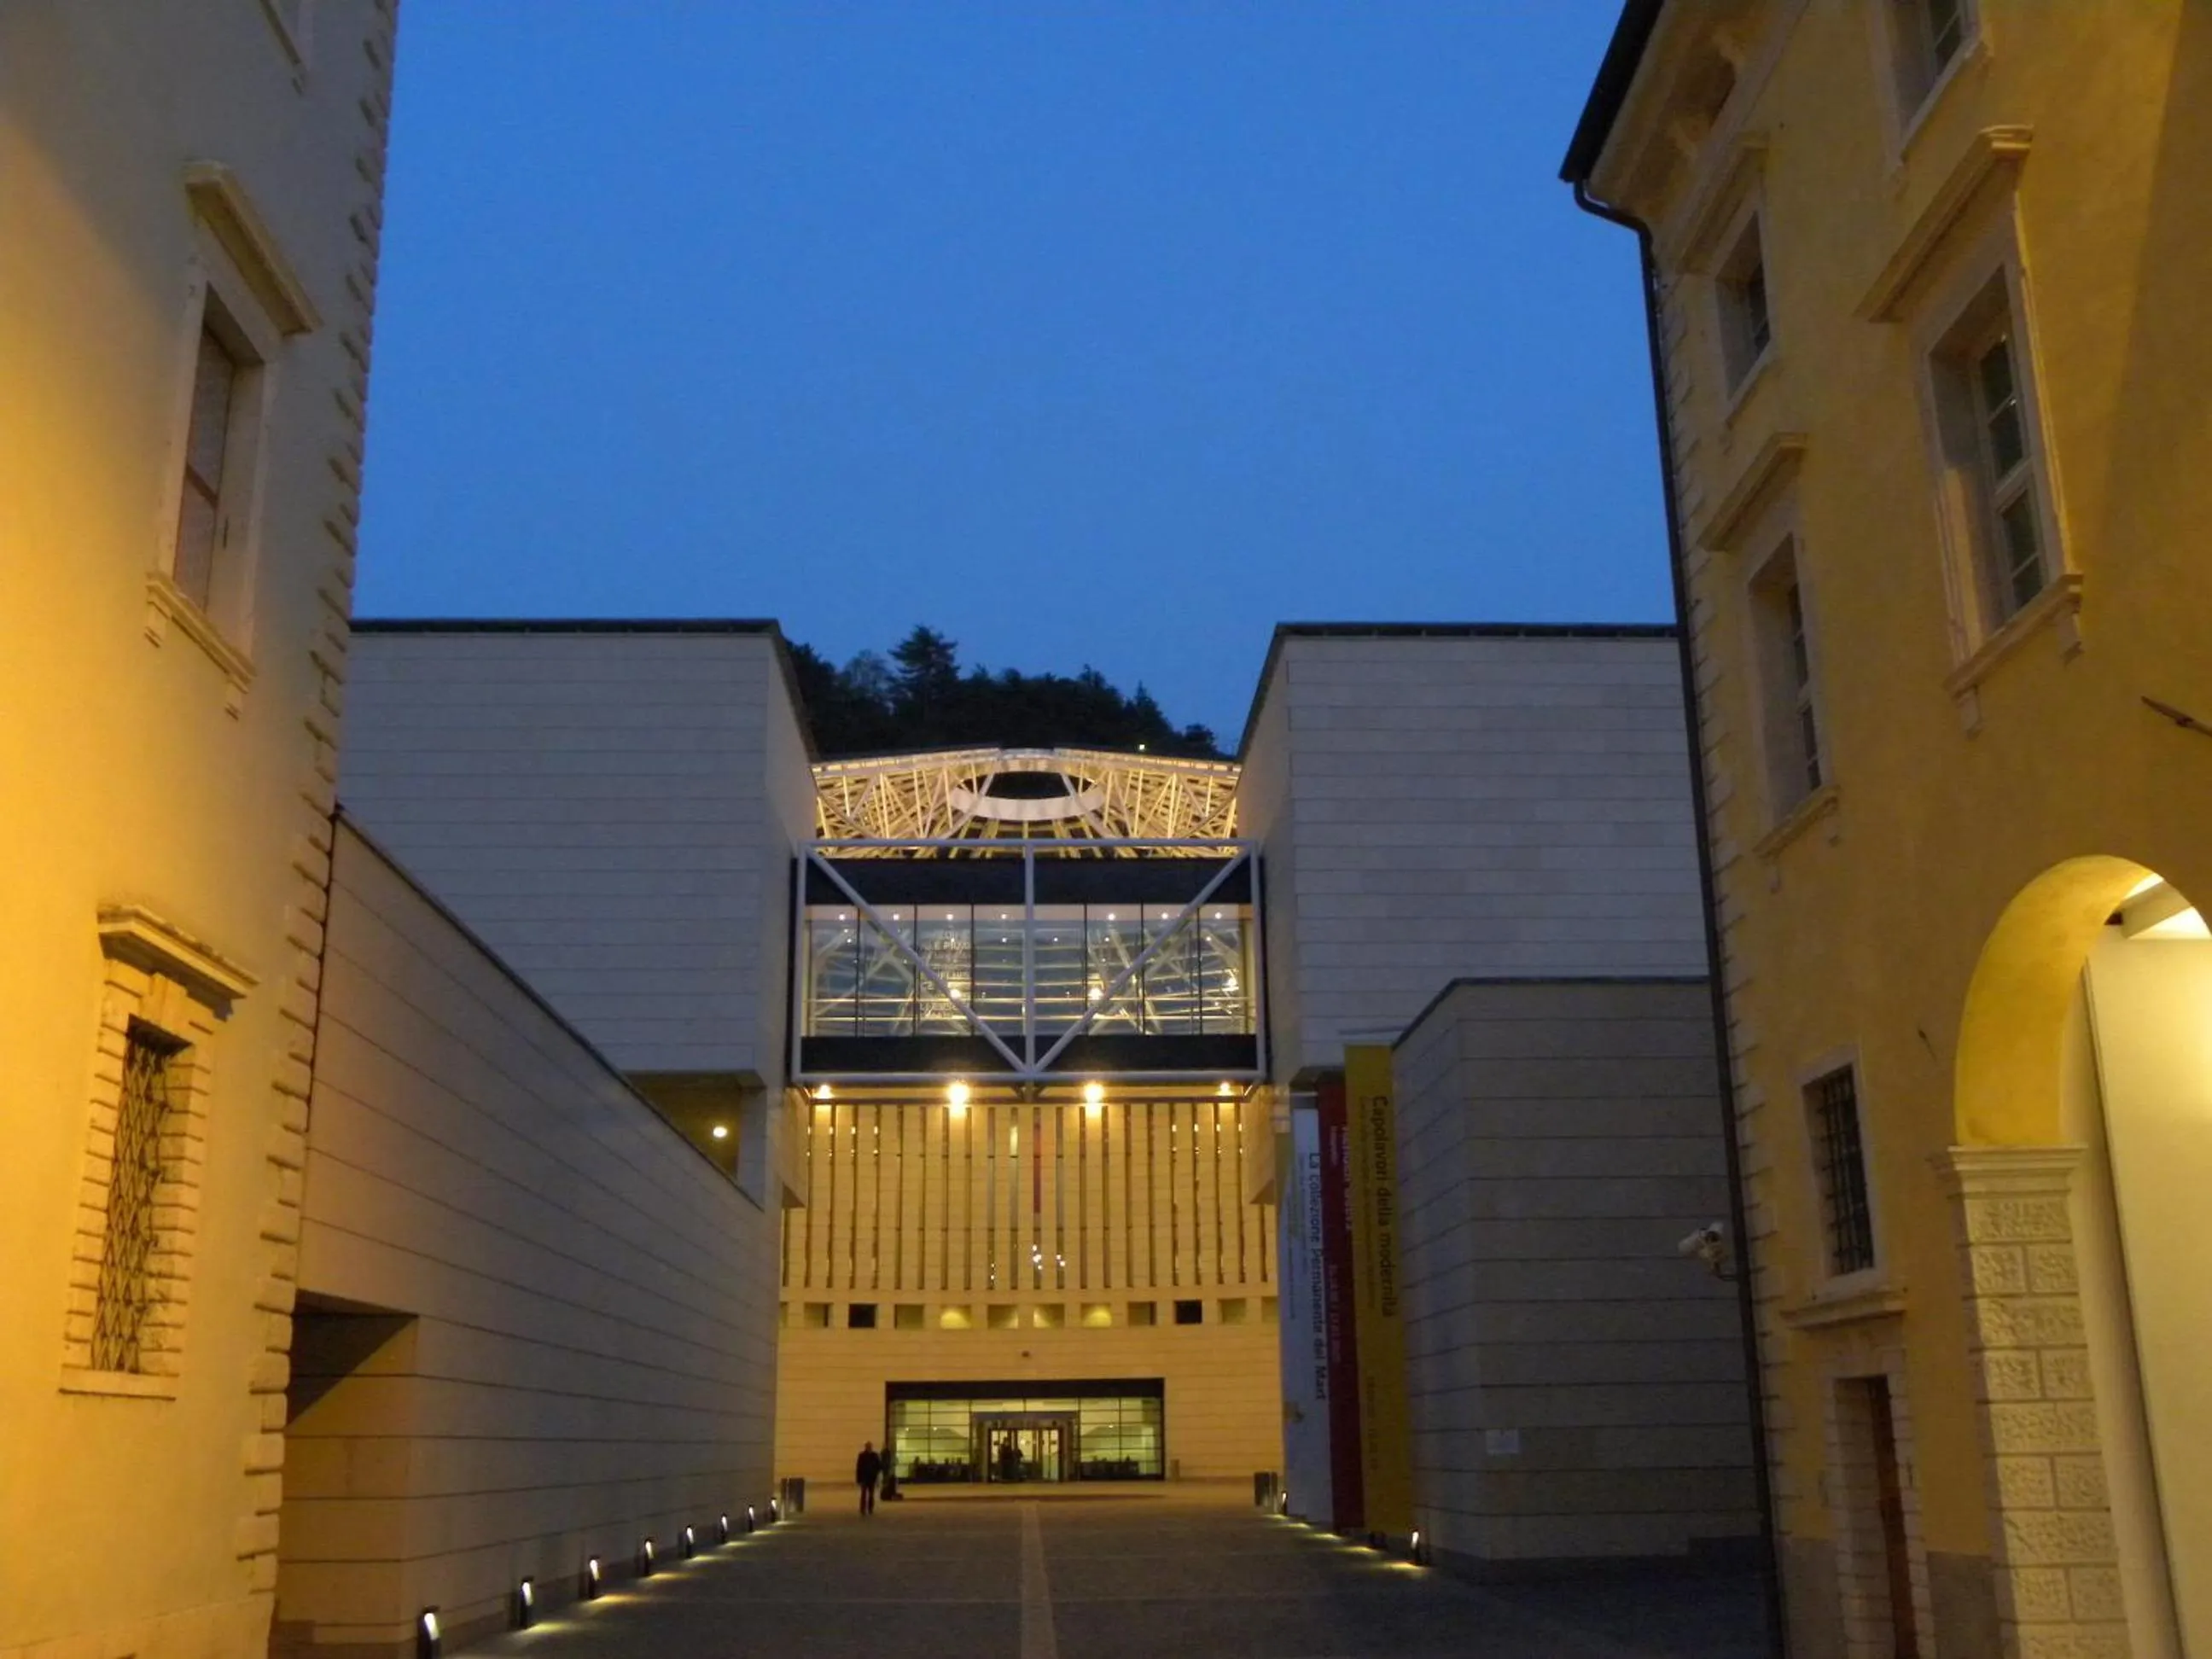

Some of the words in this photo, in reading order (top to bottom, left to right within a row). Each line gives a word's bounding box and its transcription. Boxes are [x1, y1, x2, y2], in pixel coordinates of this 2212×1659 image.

[1370, 1096, 1393, 1181] Capolavori
[1308, 1152, 1321, 1169] La
[1376, 1188, 1394, 1227] della
[1313, 1338, 1327, 1359] del
[1315, 1365, 1328, 1400] Mart
